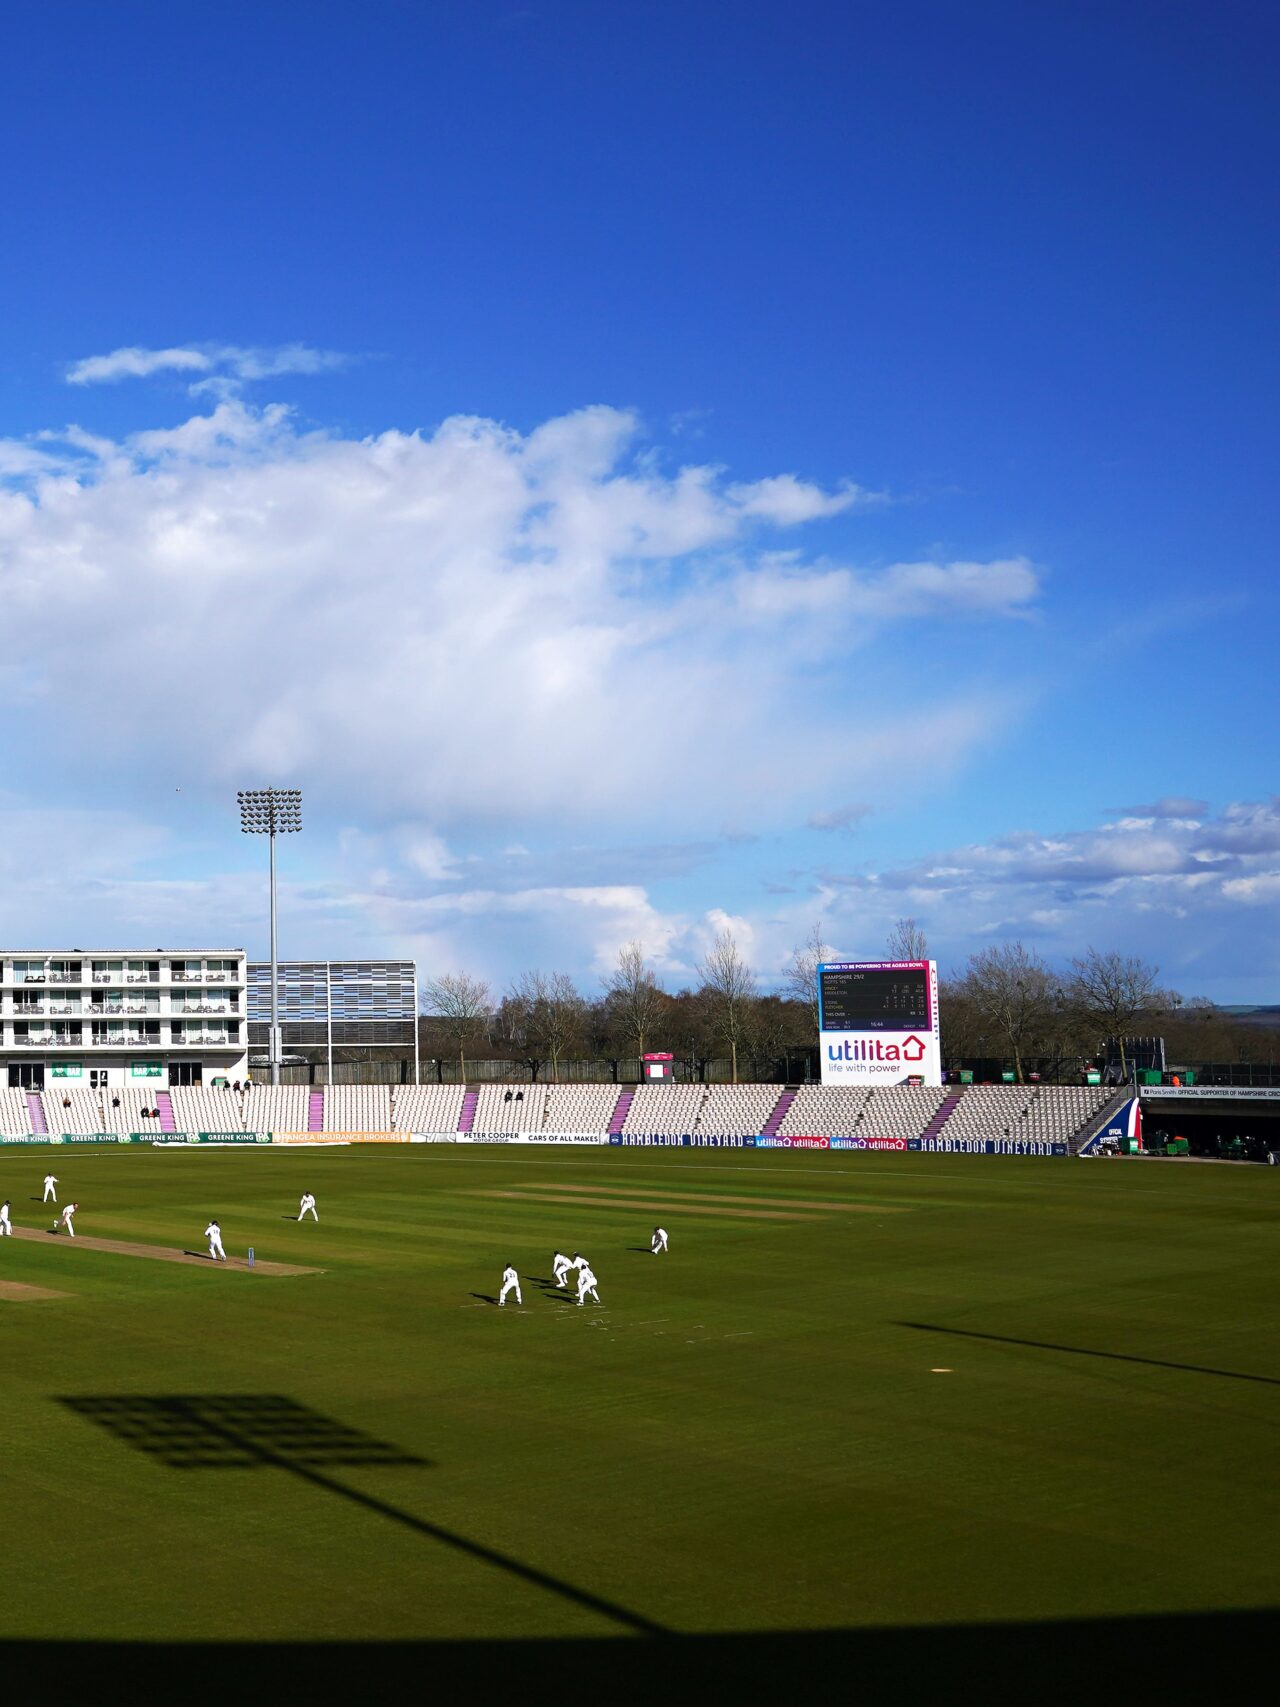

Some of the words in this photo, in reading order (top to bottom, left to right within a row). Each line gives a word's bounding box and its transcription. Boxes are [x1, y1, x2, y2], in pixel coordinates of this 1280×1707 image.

[828, 1040, 900, 1061] utilita
[828, 1063, 843, 1072] life
[846, 1063, 866, 1072] with
[869, 1065, 900, 1074] power
[622, 1134, 683, 1146] HAMBLEDON
[690, 1134, 743, 1147] VINEYARD
[756, 1138, 783, 1147] utilita
[794, 1138, 819, 1148] utilita
[832, 1138, 858, 1148] utilita
[868, 1139, 895, 1150] utilita
[921, 1138, 986, 1153] HAMBLEDON
[994, 1142, 1052, 1156] VINEYARD
